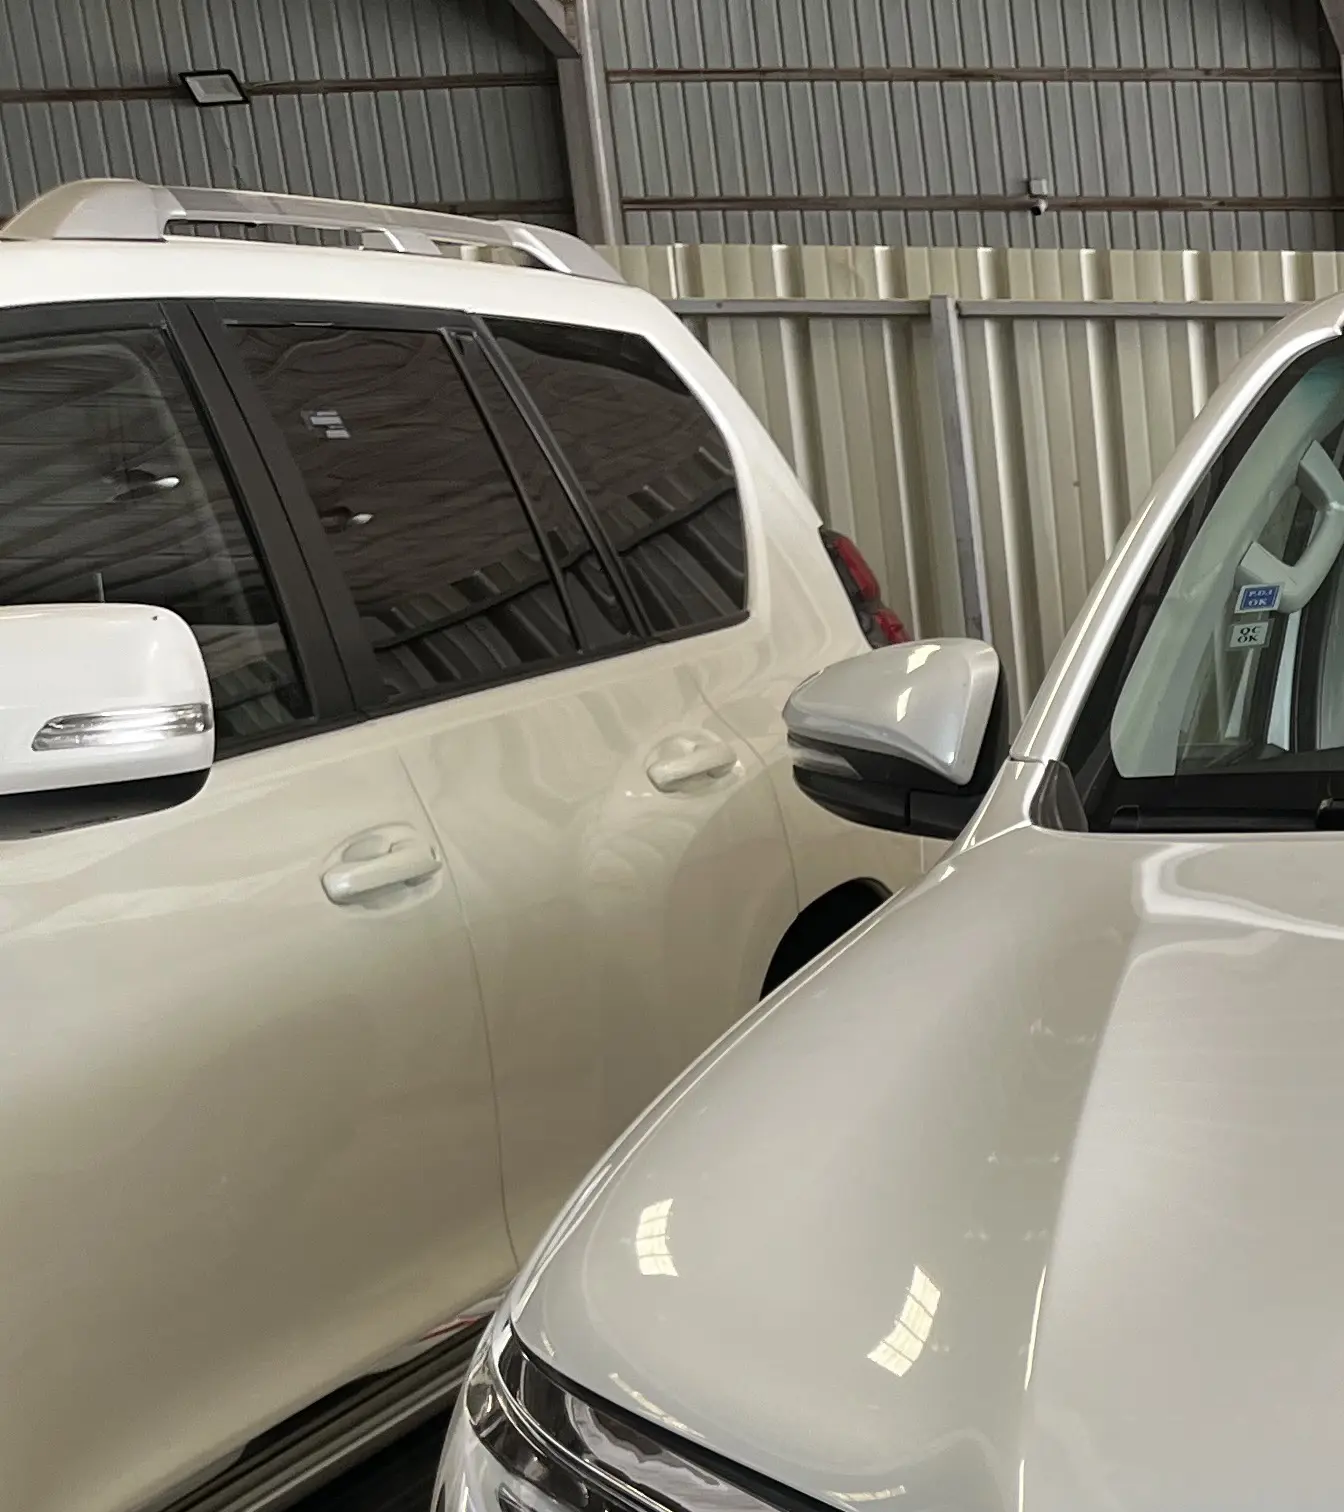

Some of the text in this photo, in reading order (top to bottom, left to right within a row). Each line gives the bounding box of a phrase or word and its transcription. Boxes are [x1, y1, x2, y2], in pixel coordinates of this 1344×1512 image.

[1248, 598, 1268, 606] OK
[1240, 625, 1260, 635] QC
[1237, 634, 1258, 643] OK
